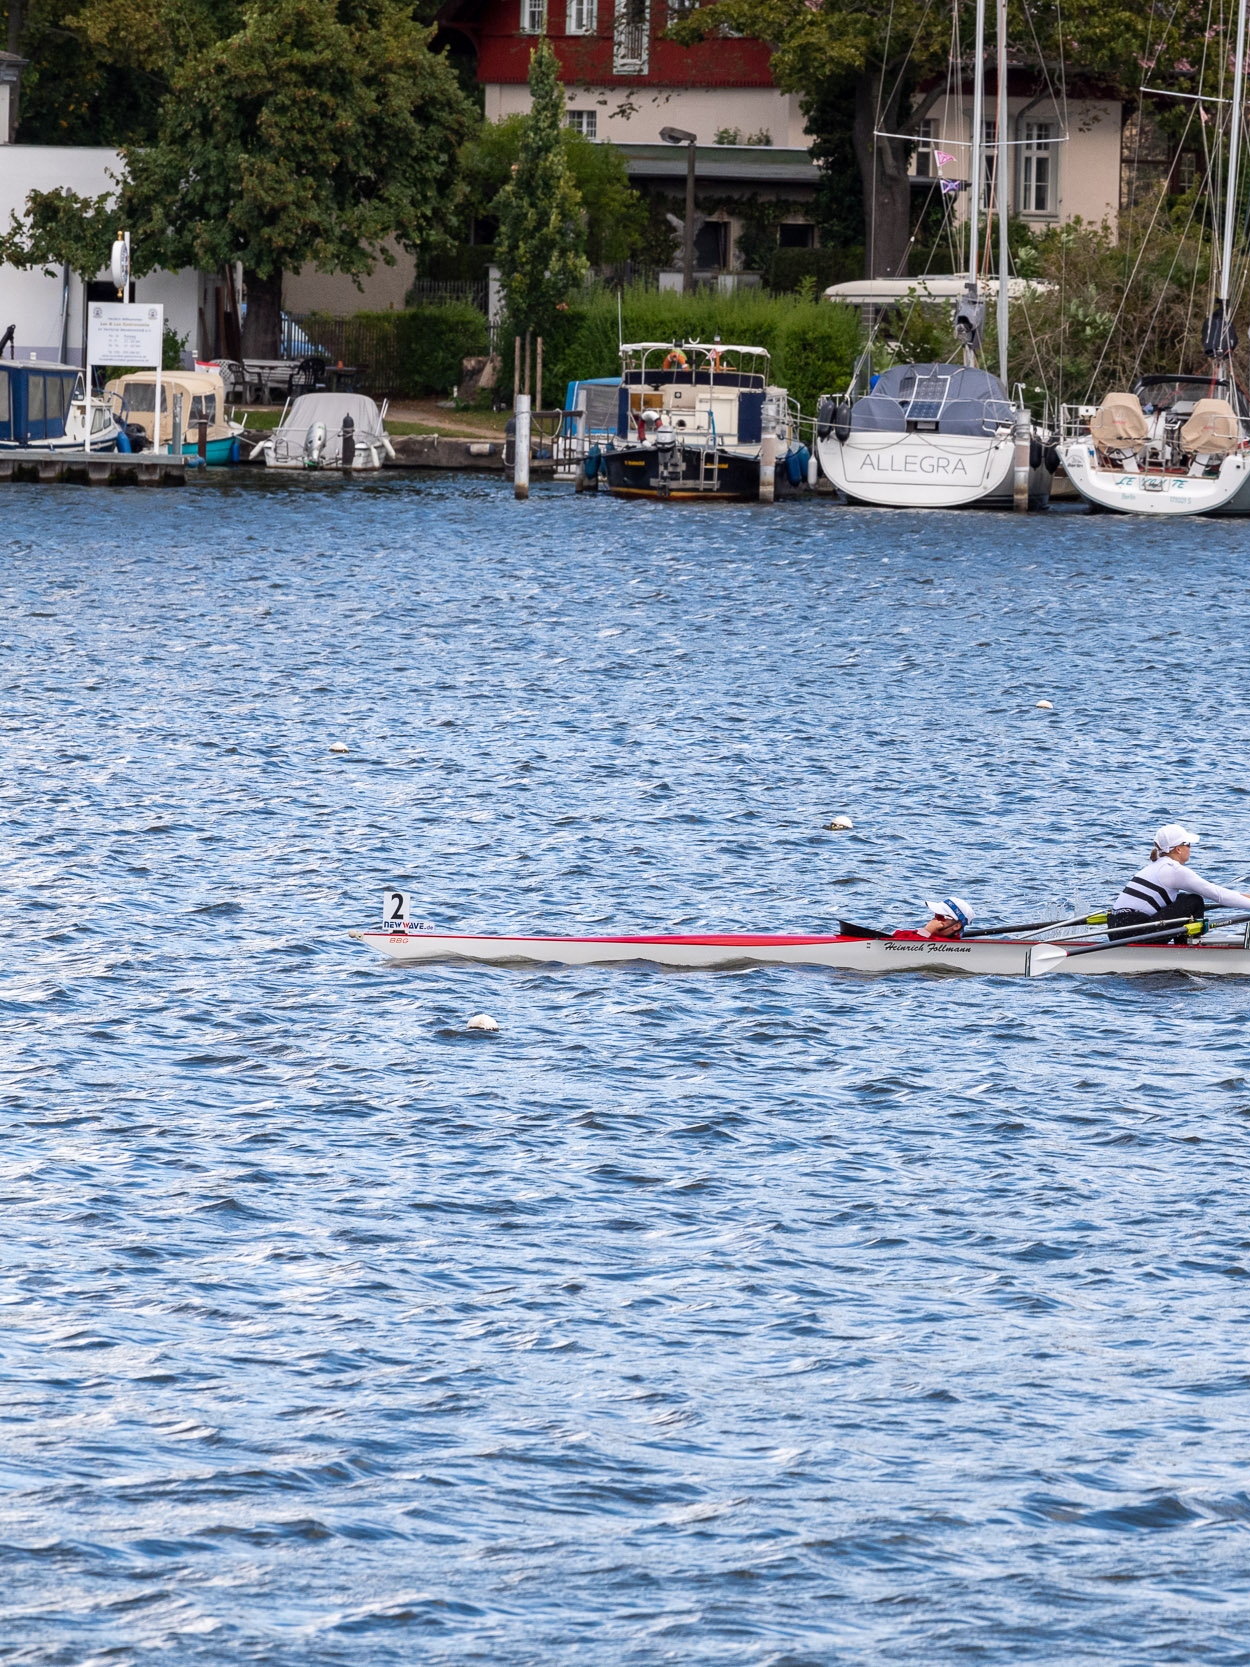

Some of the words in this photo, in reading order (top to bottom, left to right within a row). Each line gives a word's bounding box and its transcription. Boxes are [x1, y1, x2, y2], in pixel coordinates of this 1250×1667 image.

[859, 453, 968, 475] ALLEGRA
[390, 893, 404, 920] 2
[884, 941, 925, 952] Heinrich
[927, 942, 972, 953] Follmann
